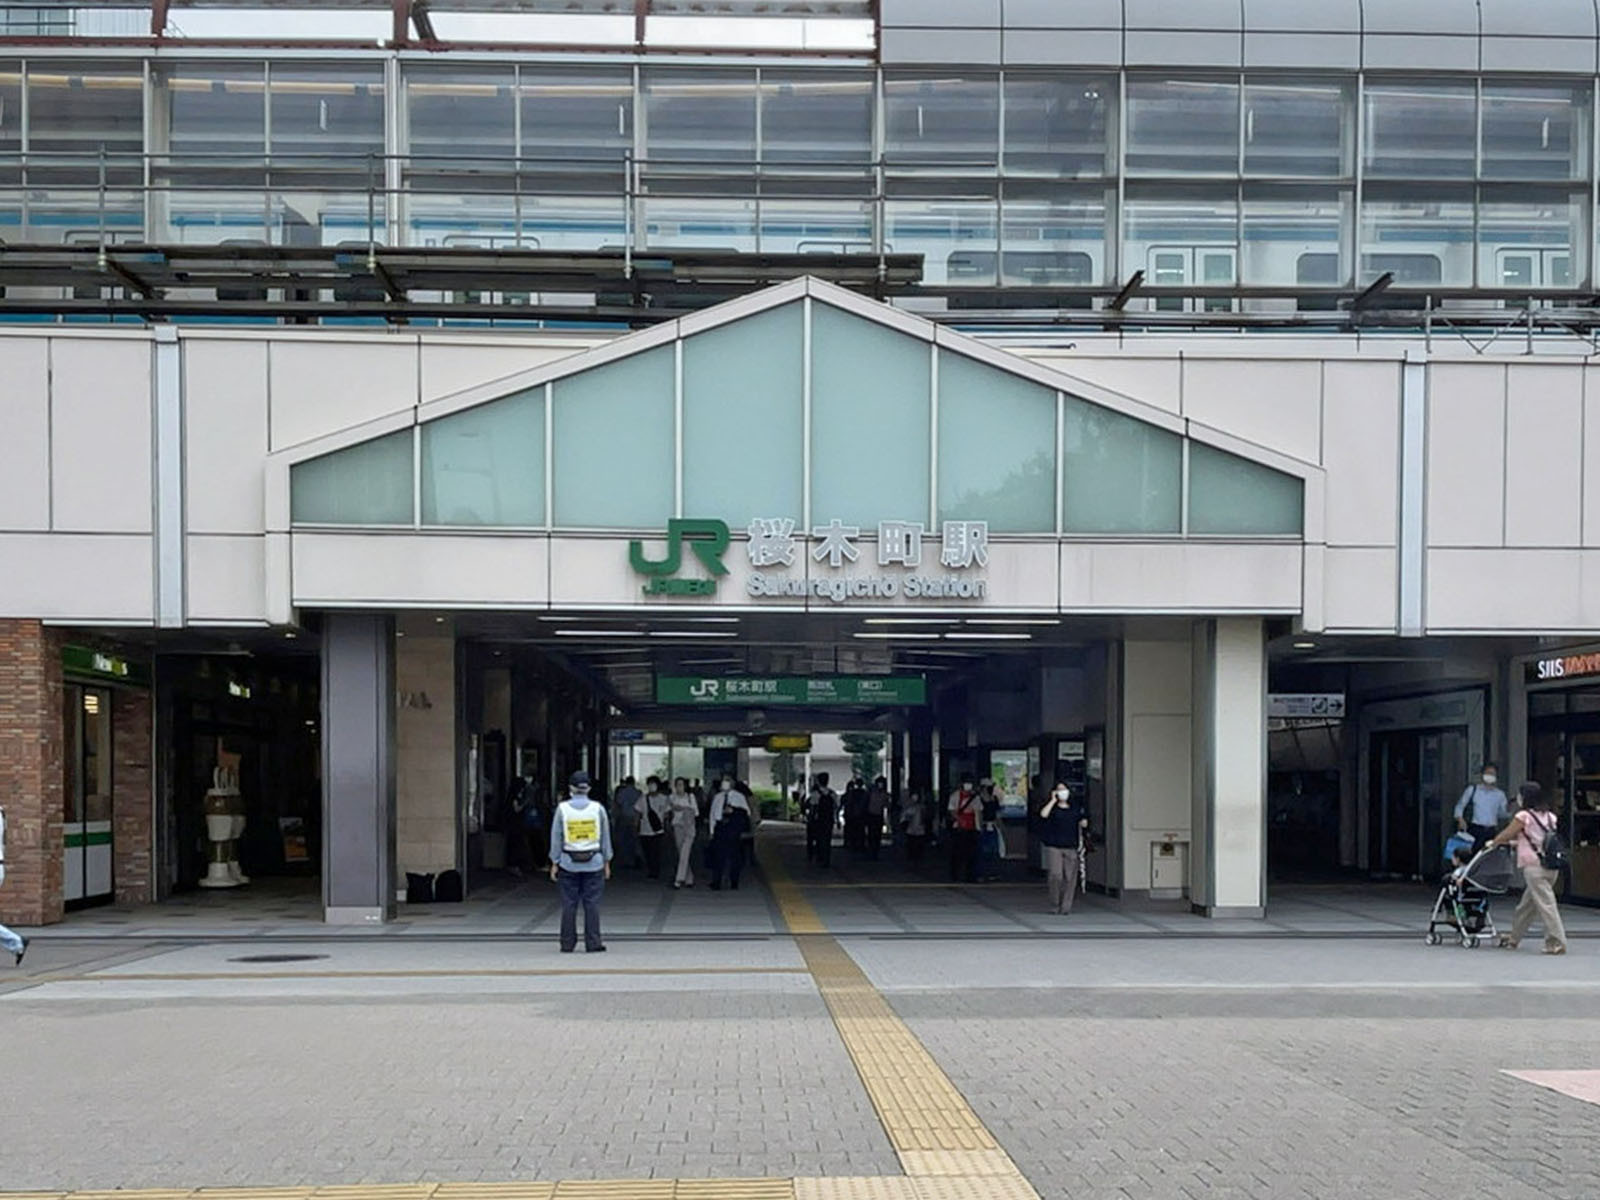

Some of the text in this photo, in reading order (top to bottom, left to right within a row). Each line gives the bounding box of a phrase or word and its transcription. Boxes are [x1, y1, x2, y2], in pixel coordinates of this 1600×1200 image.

[629, 518, 731, 577] JR
[748, 518, 989, 568] 桜木町駅
[903, 574, 987, 599] Station
[690, 679, 719, 696] JR
[725, 680, 778, 693] 桜木町駅
